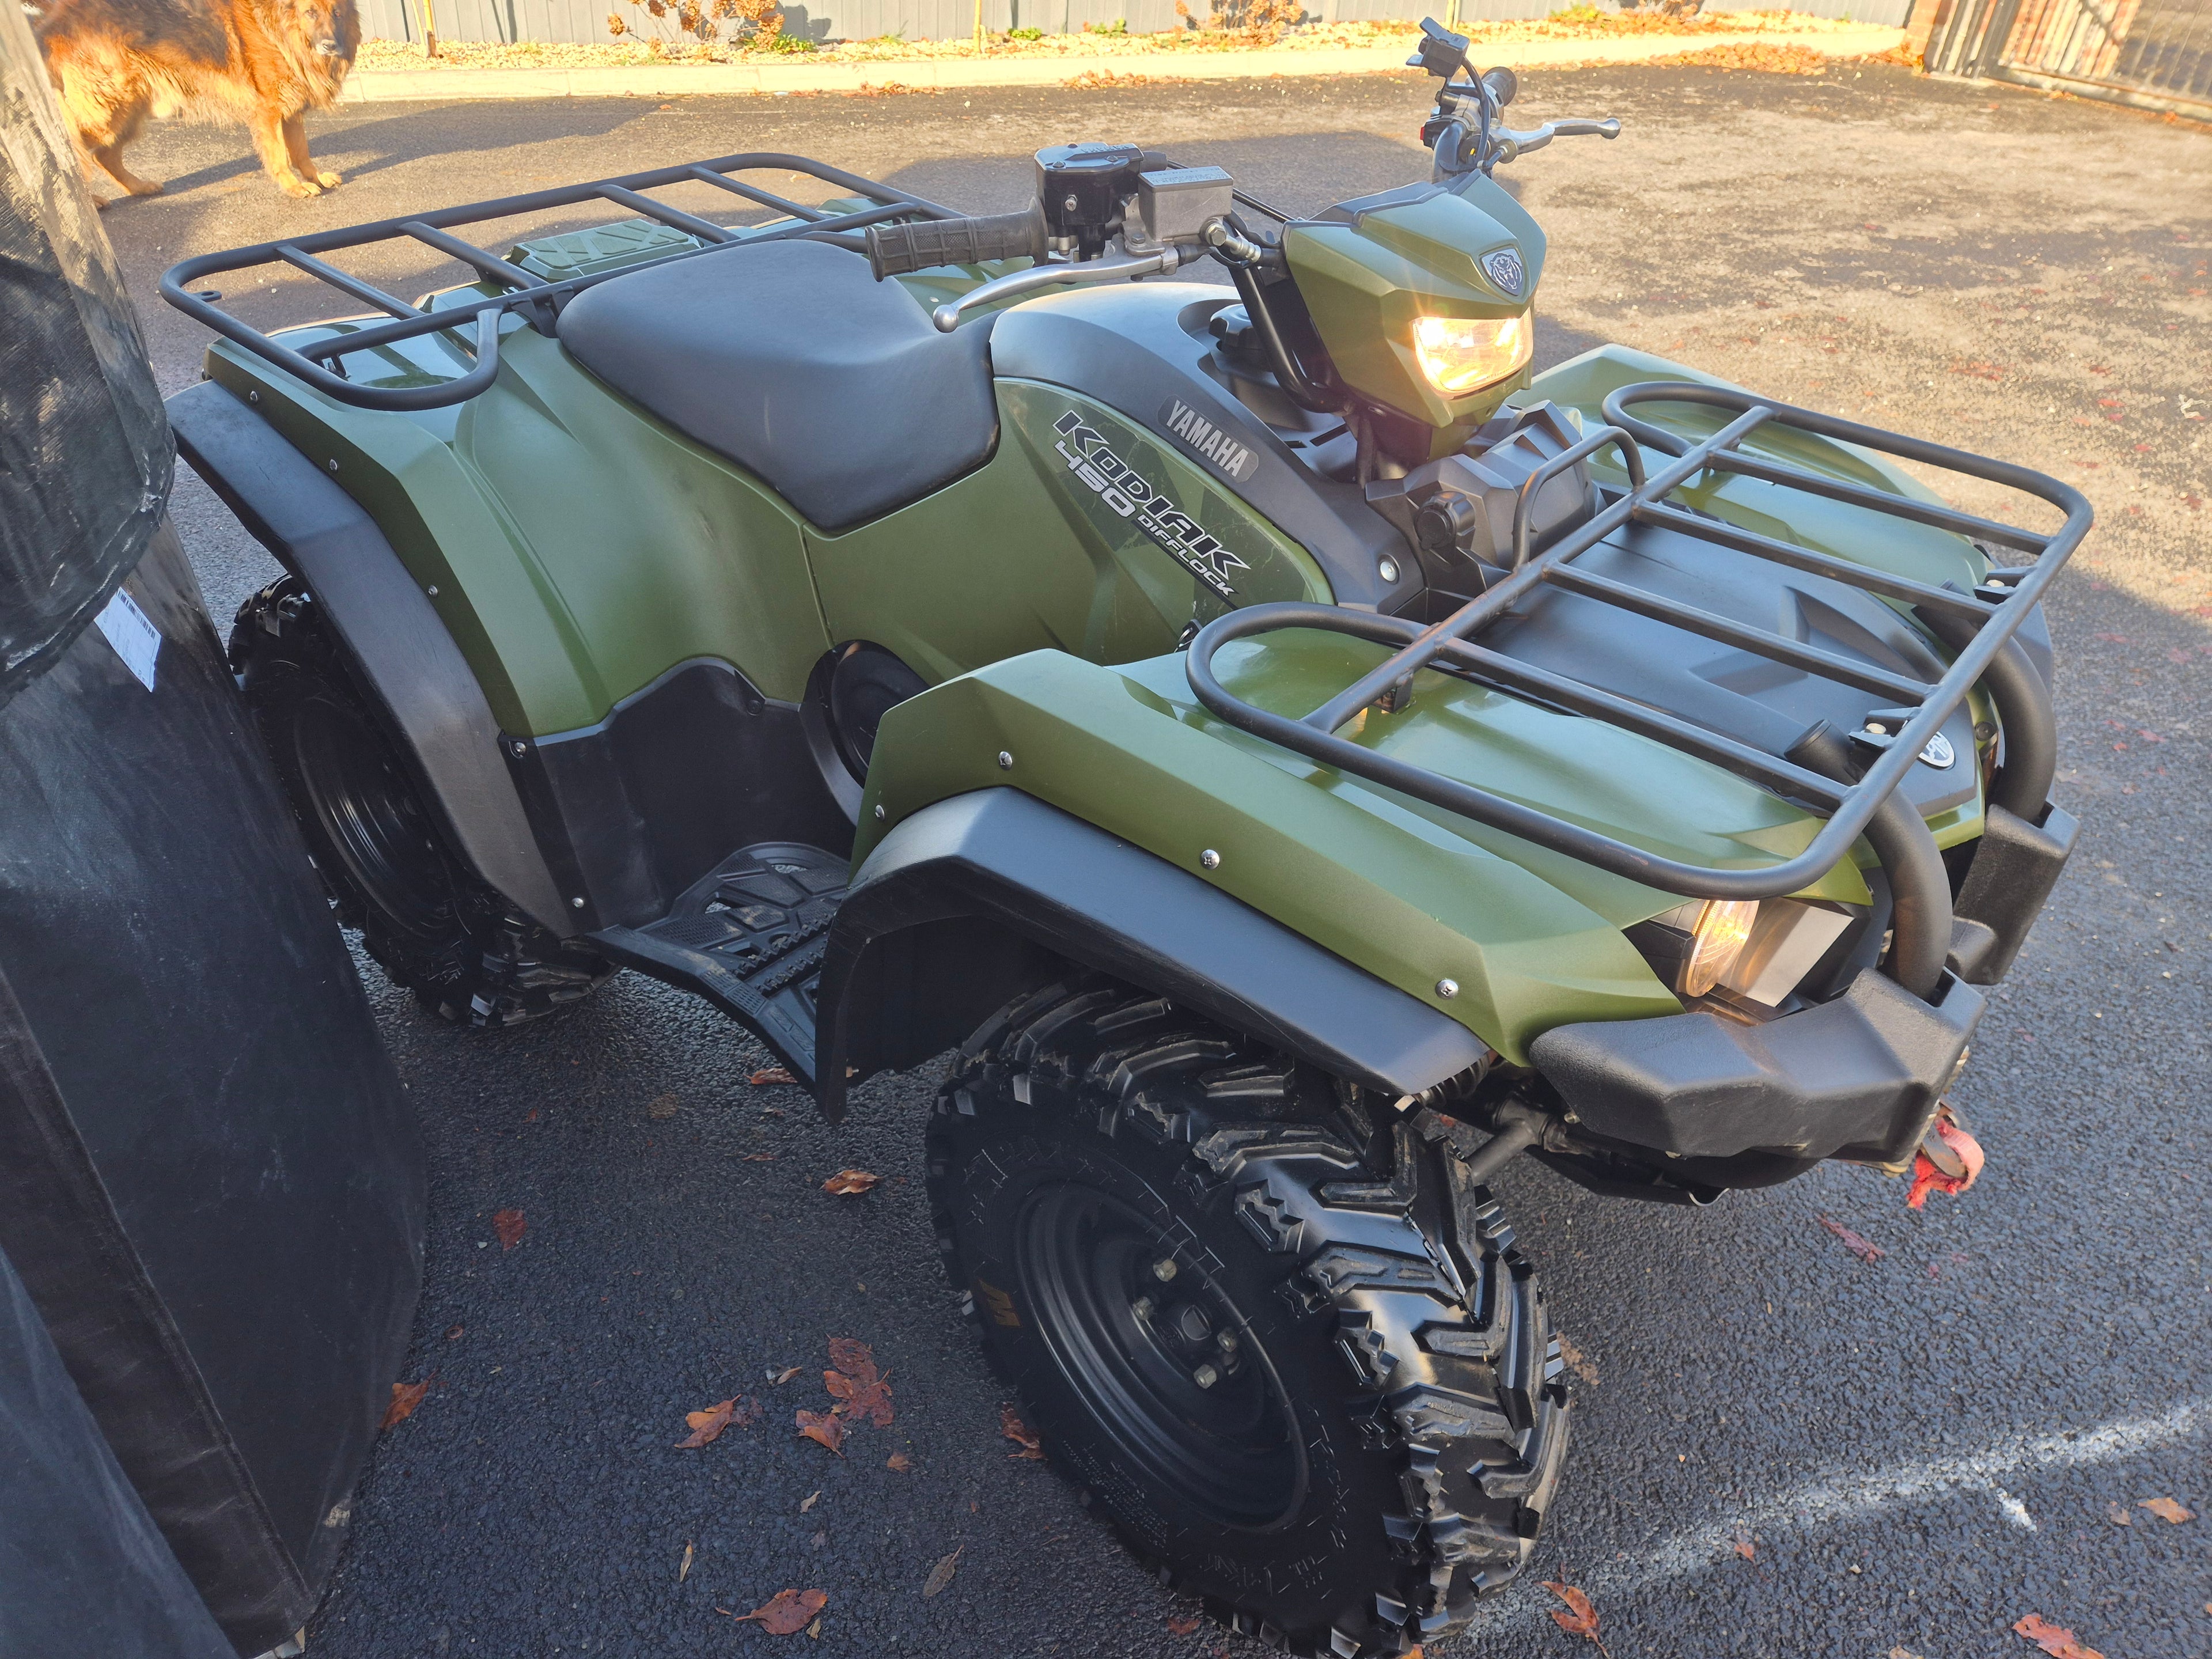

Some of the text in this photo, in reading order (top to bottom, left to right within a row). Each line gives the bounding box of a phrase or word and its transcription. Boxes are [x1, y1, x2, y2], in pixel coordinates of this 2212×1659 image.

[1054, 440, 1137, 518] 450
[1166, 399, 1248, 478] YAMAHA
[1052, 409, 1252, 581] KODIAK
[1137, 513, 1235, 597] DIFFLOCK
